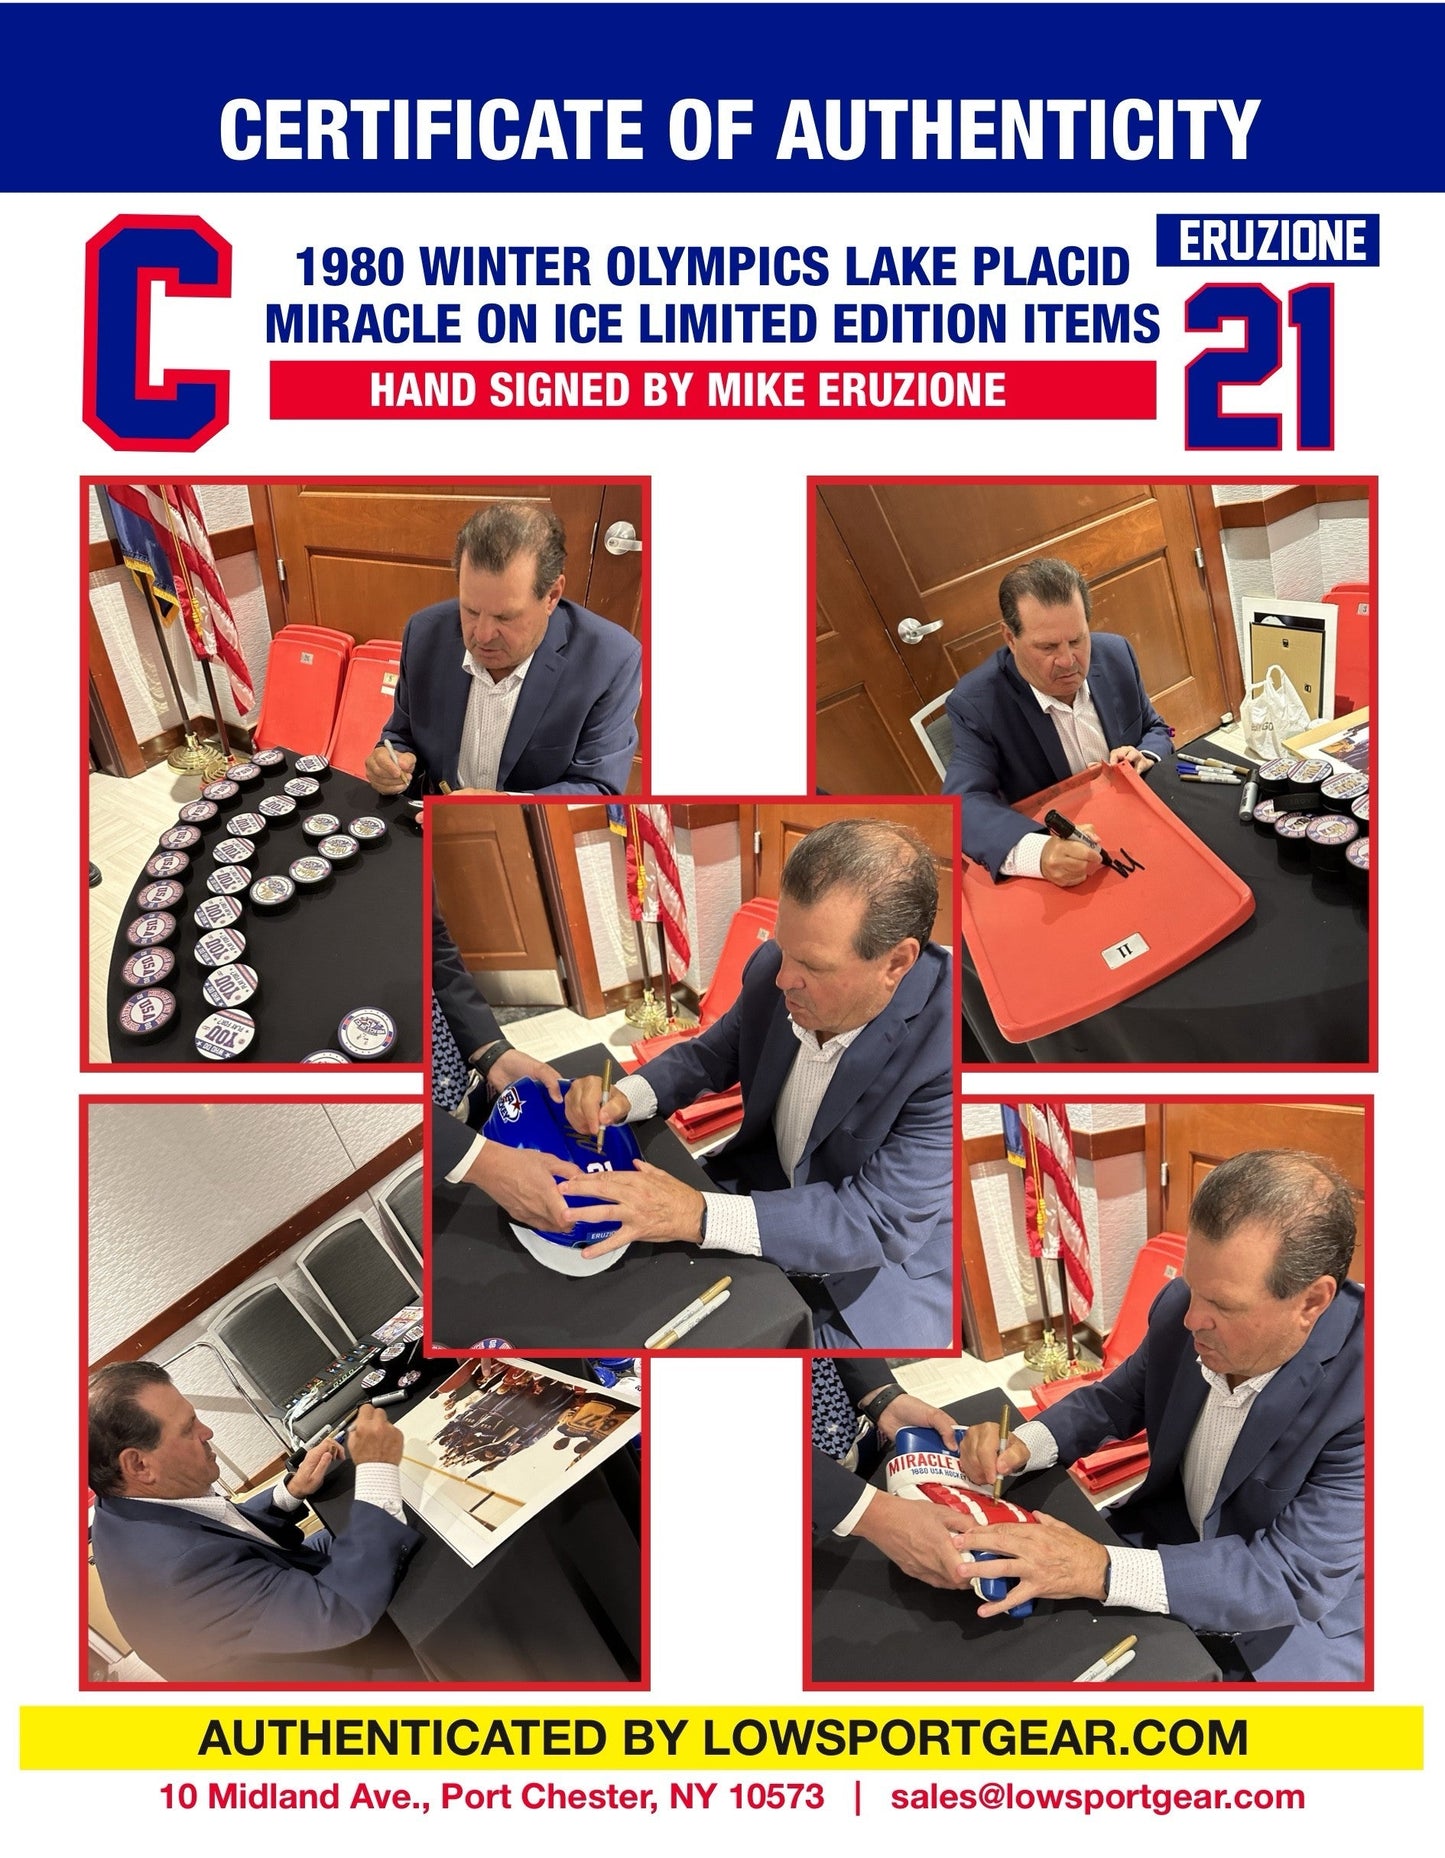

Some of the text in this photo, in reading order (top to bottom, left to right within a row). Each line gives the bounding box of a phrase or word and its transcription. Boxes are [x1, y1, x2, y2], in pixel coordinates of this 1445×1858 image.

[221, 99, 1261, 160] CERTIFICATE OF AUTHENTICITY
[1180, 220, 1366, 260] ERUZIONE
[297, 246, 1129, 286] 1980 WINTER OLYMPICS LAKE PLACID
[82, 214, 232, 452] C
[267, 303, 1160, 343] MIRACLE ON ICE LIMITED EDITION ITEMS
[1185, 283, 1334, 451] 21
[372, 372, 1005, 406] HAND SIGNED BY MIKE ERUZIONE
[237, 819, 252, 832] YOU
[173, 832, 187, 842] USA
[161, 857, 173, 869] USA
[222, 845, 241, 859] YOU
[217, 873, 236, 889] YOU
[152, 887, 168, 901] USA
[205, 904, 226, 923] YOU
[143, 920, 157, 936] USA
[206, 938, 229, 960] YOU
[142, 957, 155, 976] USA
[215, 975, 240, 1000] YOU
[139, 999, 155, 1021] USA
[205, 1026, 238, 1048] YOU
[889, 1454, 954, 1476] MIRACLE
[198, 1719, 1246, 1756] AUTHENTICATED BY LOWSPORTGEAR.COM
[161, 1783, 1304, 1815] 10 Midland Ave., Port Chester, NY 10573 sales@lowsportgear.com
